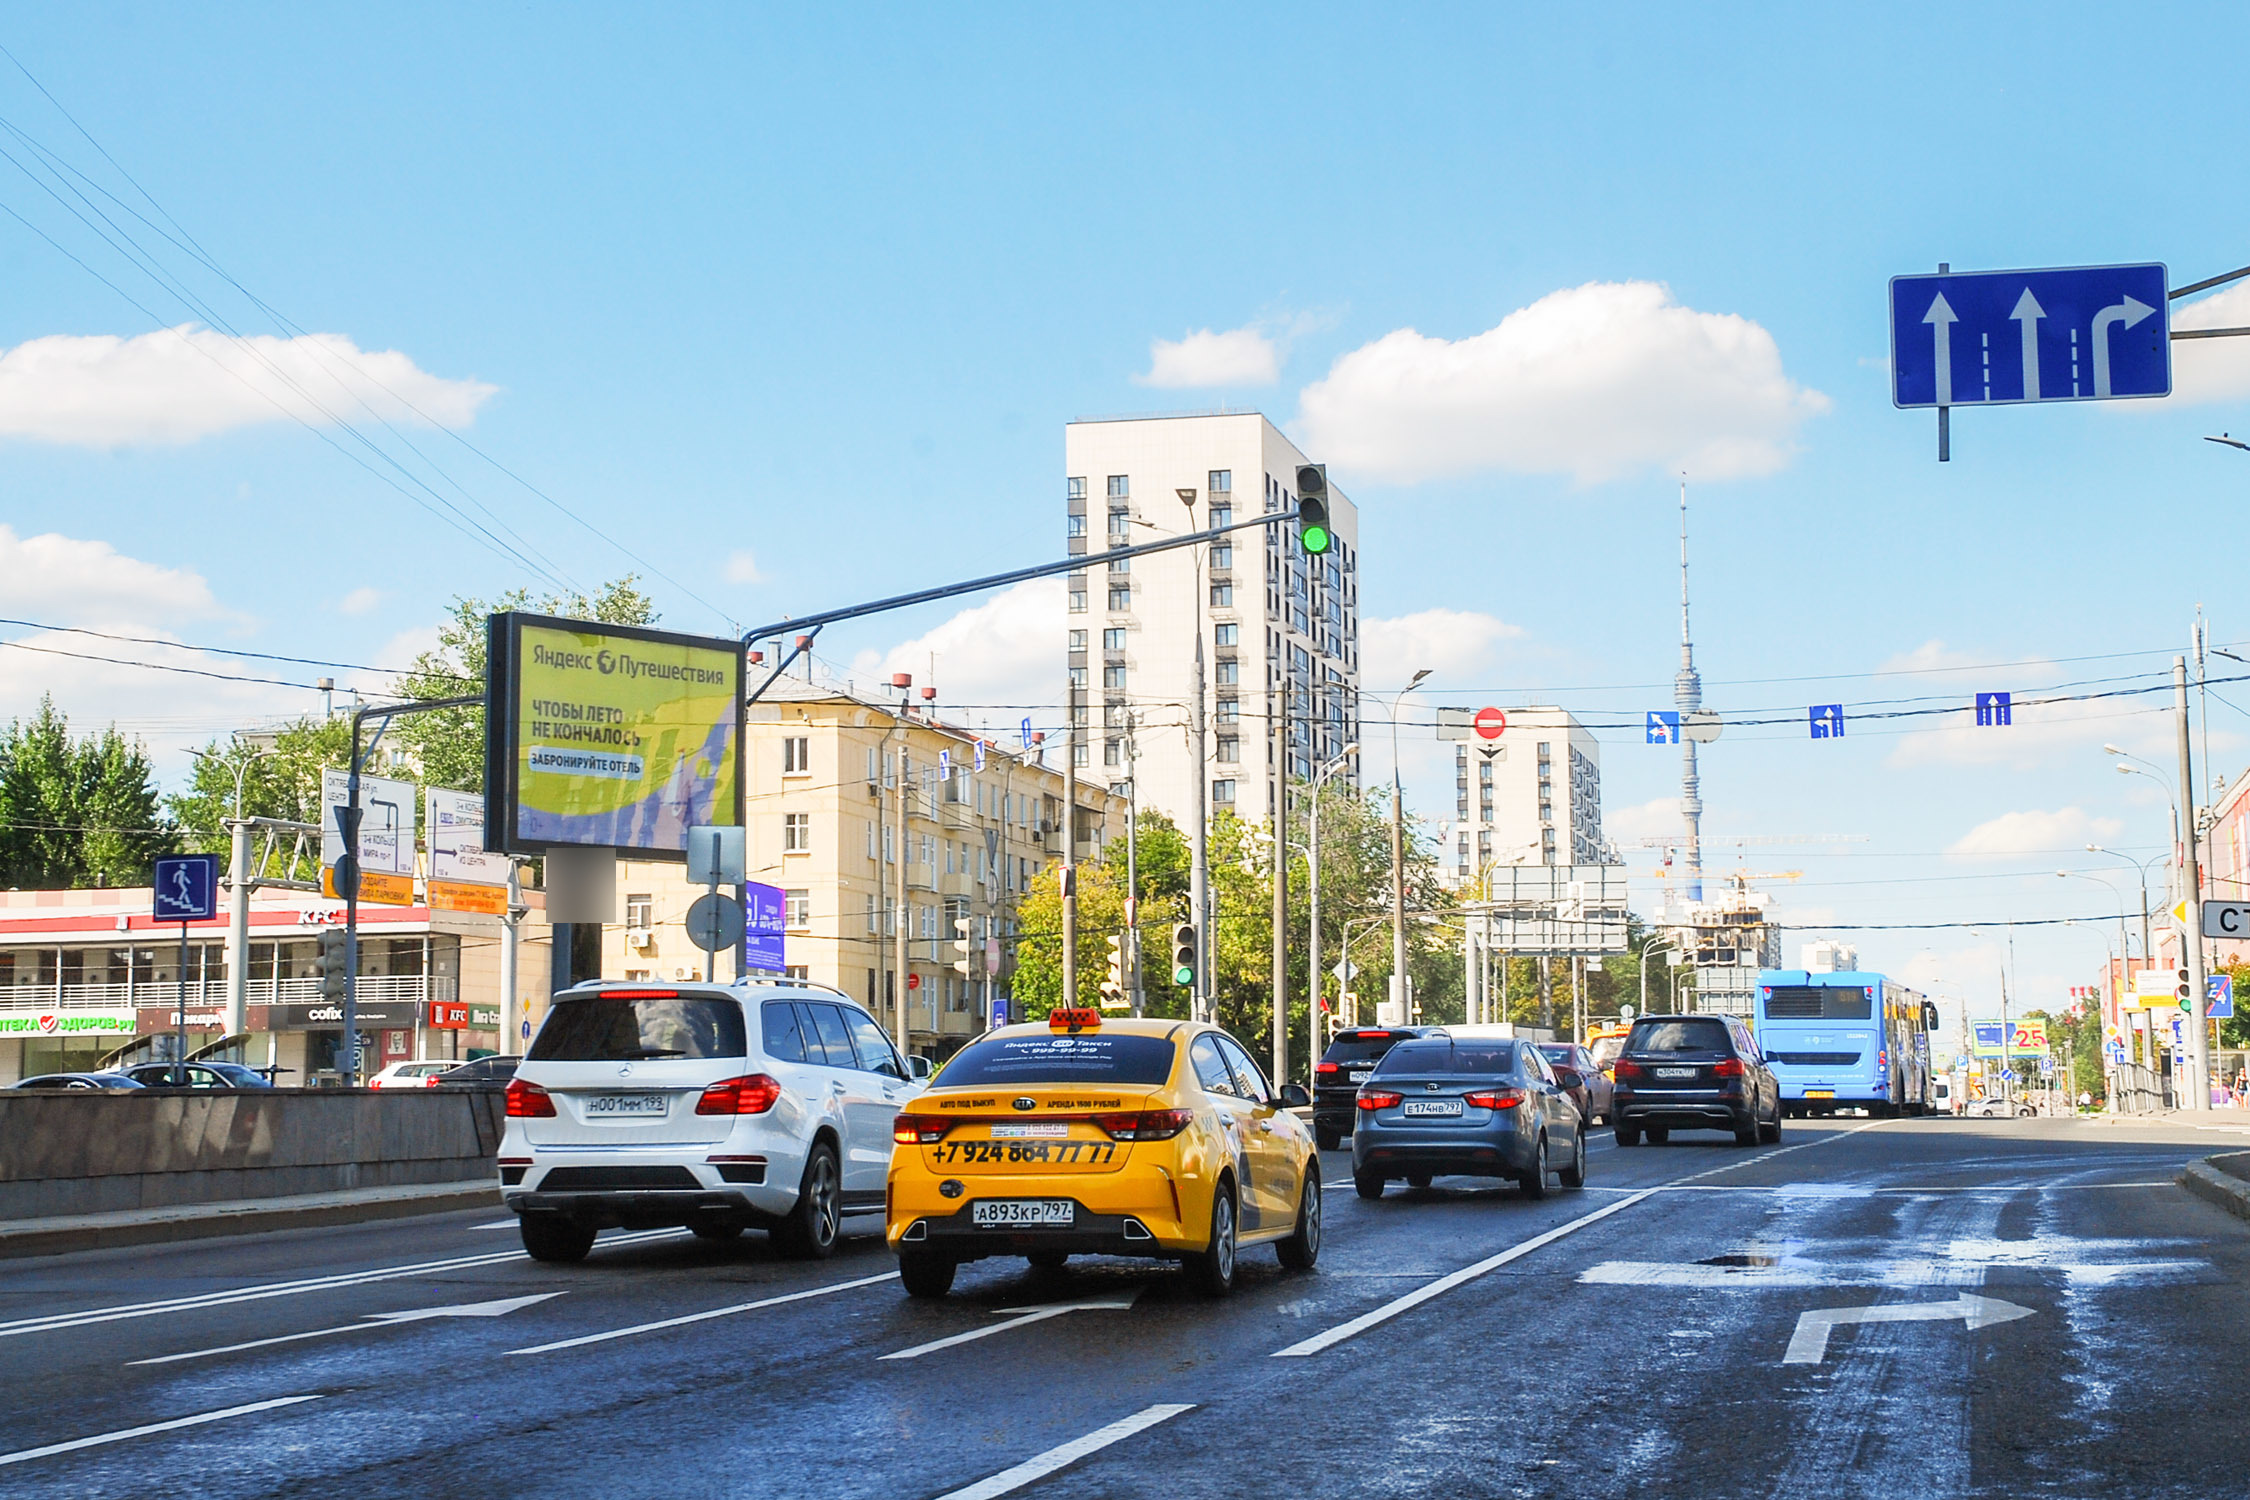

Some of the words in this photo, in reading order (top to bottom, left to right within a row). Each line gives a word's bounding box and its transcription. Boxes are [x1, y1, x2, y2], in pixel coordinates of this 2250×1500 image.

[534, 645, 592, 670] Яндекс
[620, 655, 724, 685] Путешествия
[532, 700, 582, 720] ЧТОБЫ
[586, 706, 622, 724] ЛЕТО
[532, 722, 550, 738] НЕ
[554, 724, 640, 746] КОНЧАЛОСЬ
[531, 753, 608, 771] ЗАБРОНИРУЙТЕ
[608, 760, 640, 774] ОТЕЛЬ
[297, 909, 338, 924] KFC
[308, 1006, 342, 1020] cofix
[450, 1009, 466, 1022] KFC
[59, 1016, 135, 1032] ЗДОРОВ.ру
[2016, 1030, 2048, 1047] 25
[940, 1100, 956, 1109] АВТО
[957, 1100, 971, 1108] ПОД
[972, 1099, 995, 1108] ВЫКУП
[1014, 1100, 1034, 1108] KIA
[1047, 1100, 1075, 1108] АРЕНДА
[1094, 1099, 1121, 1108] РУБЛЕЙ
[1407, 1104, 1444, 1113] Е174НВ
[933, 1142, 959, 1162] +7
[964, 1142, 1003, 1162] 924
[1008, 1142, 1049, 1162] 864
[1055, 1142, 1086, 1162] 77
[1086, 1142, 1116, 1163] 77
[978, 1204, 1041, 1220] А893КР
[1044, 1202, 1068, 1216] 797
